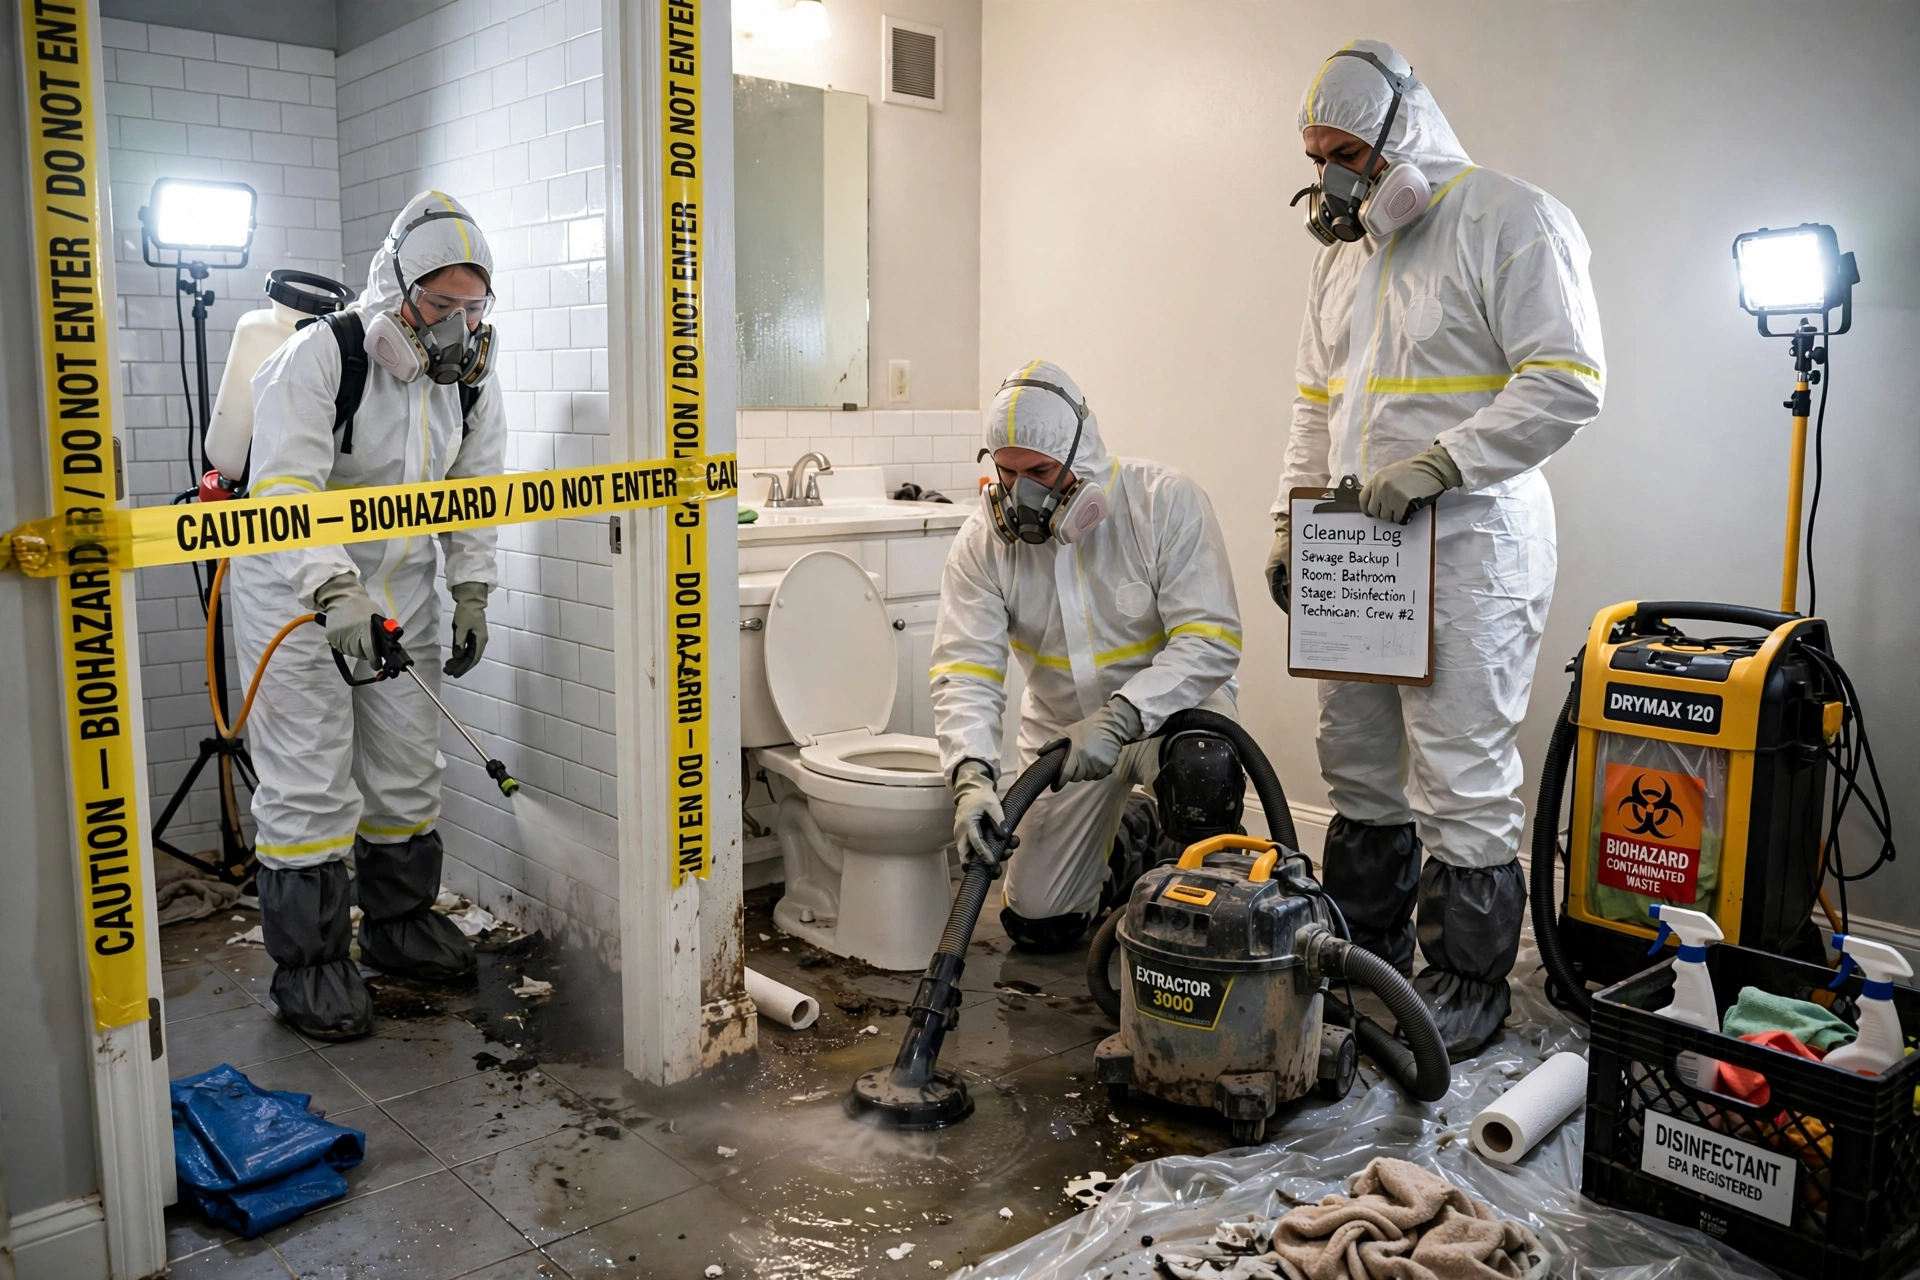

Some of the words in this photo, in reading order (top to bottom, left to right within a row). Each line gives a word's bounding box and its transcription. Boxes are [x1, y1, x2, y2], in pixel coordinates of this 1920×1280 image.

[40, 71, 83, 140] NOT
[670, 81, 694, 135] NOT
[44, 150, 85, 196] DO
[670, 143, 695, 178] DO
[672, 203, 696, 280] ENTER
[50, 238, 95, 342] ENTER
[673, 288, 697, 337] NOT
[673, 346, 697, 378] DO
[57, 353, 99, 418] NOT
[62, 430, 102, 474] DO
[178, 505, 310, 551] CAUTION
[351, 487, 496, 532] BIOHAZARD
[523, 480, 554, 513] DO
[562, 475, 604, 508] NOT
[612, 468, 677, 502] ENTER
[1303, 524, 1365, 545] Cleanup
[1373, 525, 1402, 547] Log
[1302, 550, 1343, 566] Sewage
[1350, 551, 1389, 567] Backup
[1302, 568, 1336, 581] Room:
[1342, 569, 1395, 583] Bathroom
[1301, 586, 1336, 601] Stage:
[1342, 587, 1405, 601] Disinfection
[1366, 607, 1393, 619] Crew
[1399, 609, 1414, 620] #2
[68, 541, 119, 740] BIOHAZARD
[1611, 693, 1682, 718] DRYMAX
[1687, 704, 1714, 722] 120
[1606, 838, 1689, 869] BIOHAZARD
[1607, 857, 1686, 884] CONTAMINATED
[86, 798, 134, 955] CAUTION
[1626, 875, 1661, 893] WASTE
[1137, 966, 1210, 997] EXTRACTOR
[1153, 990, 1194, 1013] 3000
[1656, 1123, 1781, 1187] DISINFECTANT
[1668, 1156, 1688, 1175] EPA
[1692, 1164, 1763, 1201] REGISTERED
